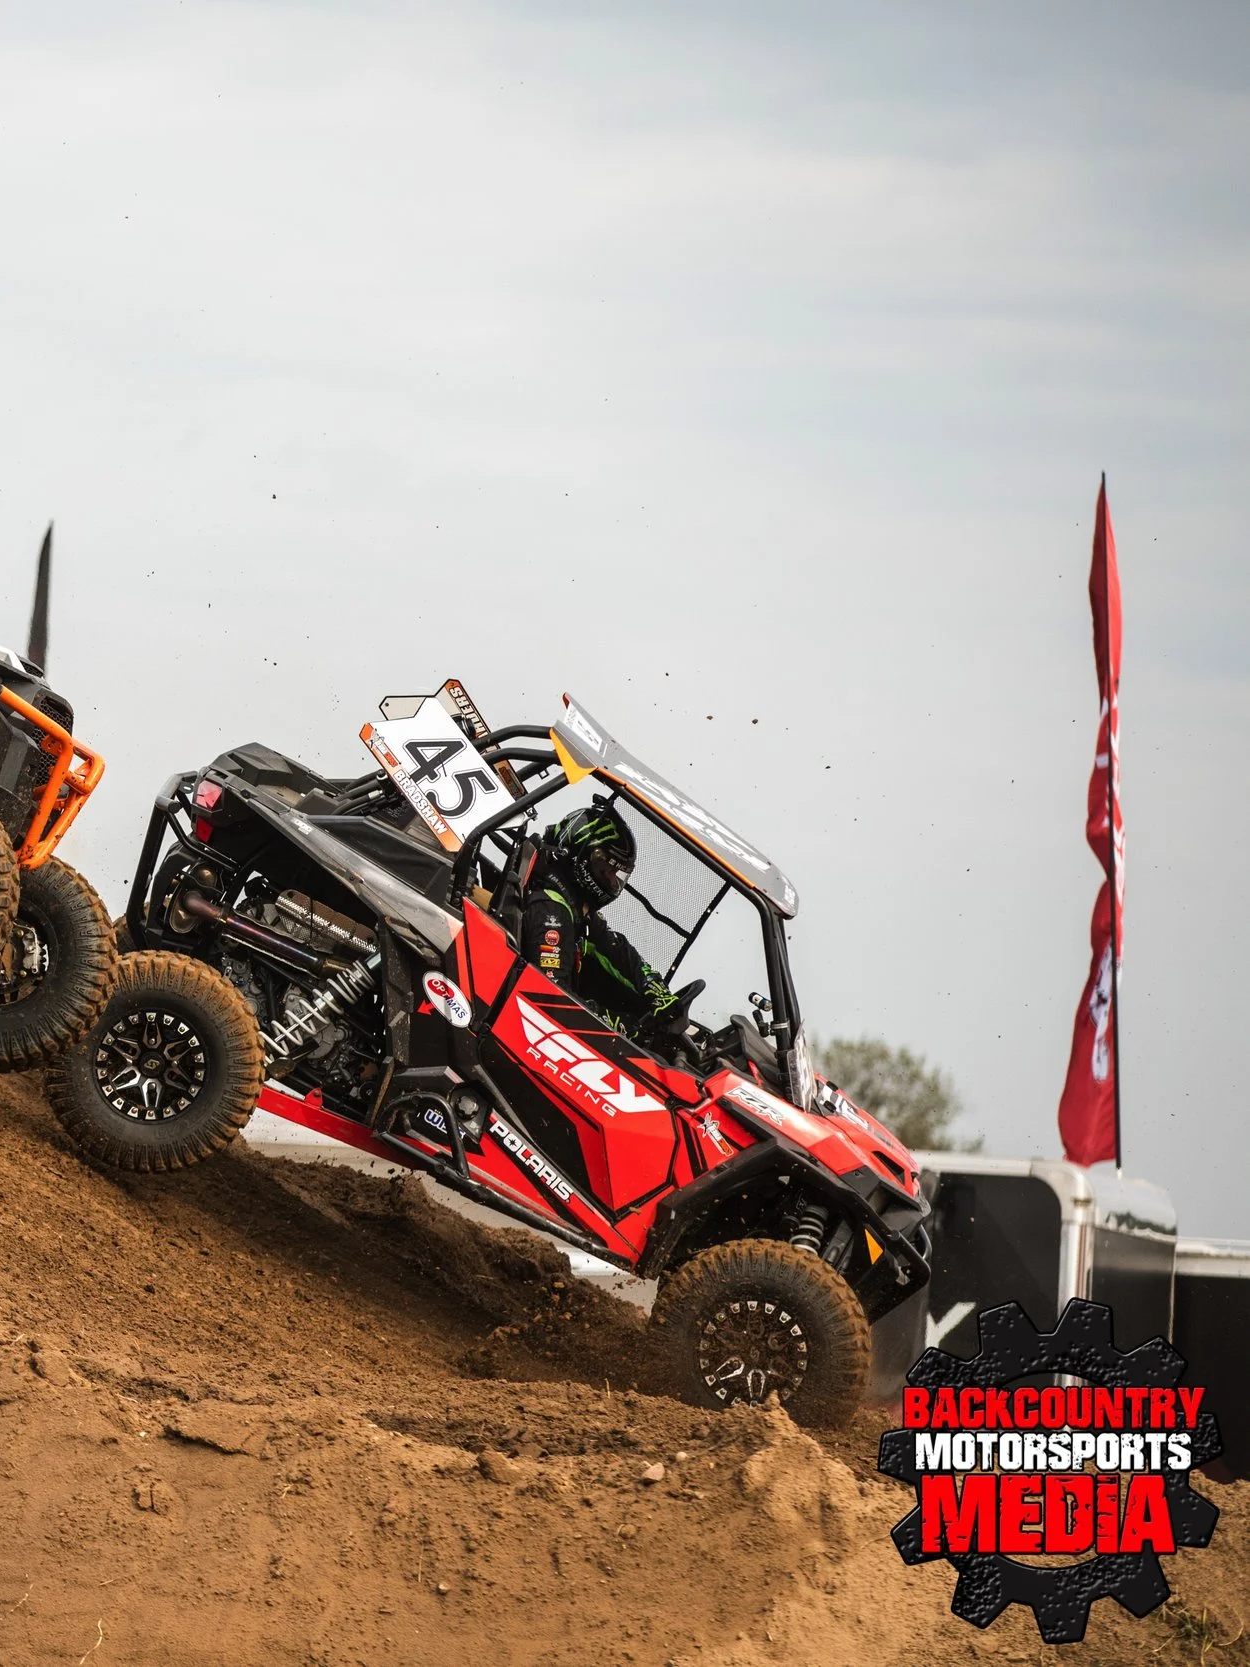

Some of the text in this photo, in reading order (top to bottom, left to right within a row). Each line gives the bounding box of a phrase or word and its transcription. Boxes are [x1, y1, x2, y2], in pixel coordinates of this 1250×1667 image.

[393, 769, 449, 835] BRADSHAW
[403, 738, 499, 820] 45
[431, 980, 466, 1019] OPTIMAS
[515, 994, 668, 1114] FLY
[526, 1046, 617, 1118] RACING
[489, 1120, 574, 1202] POLARIS
